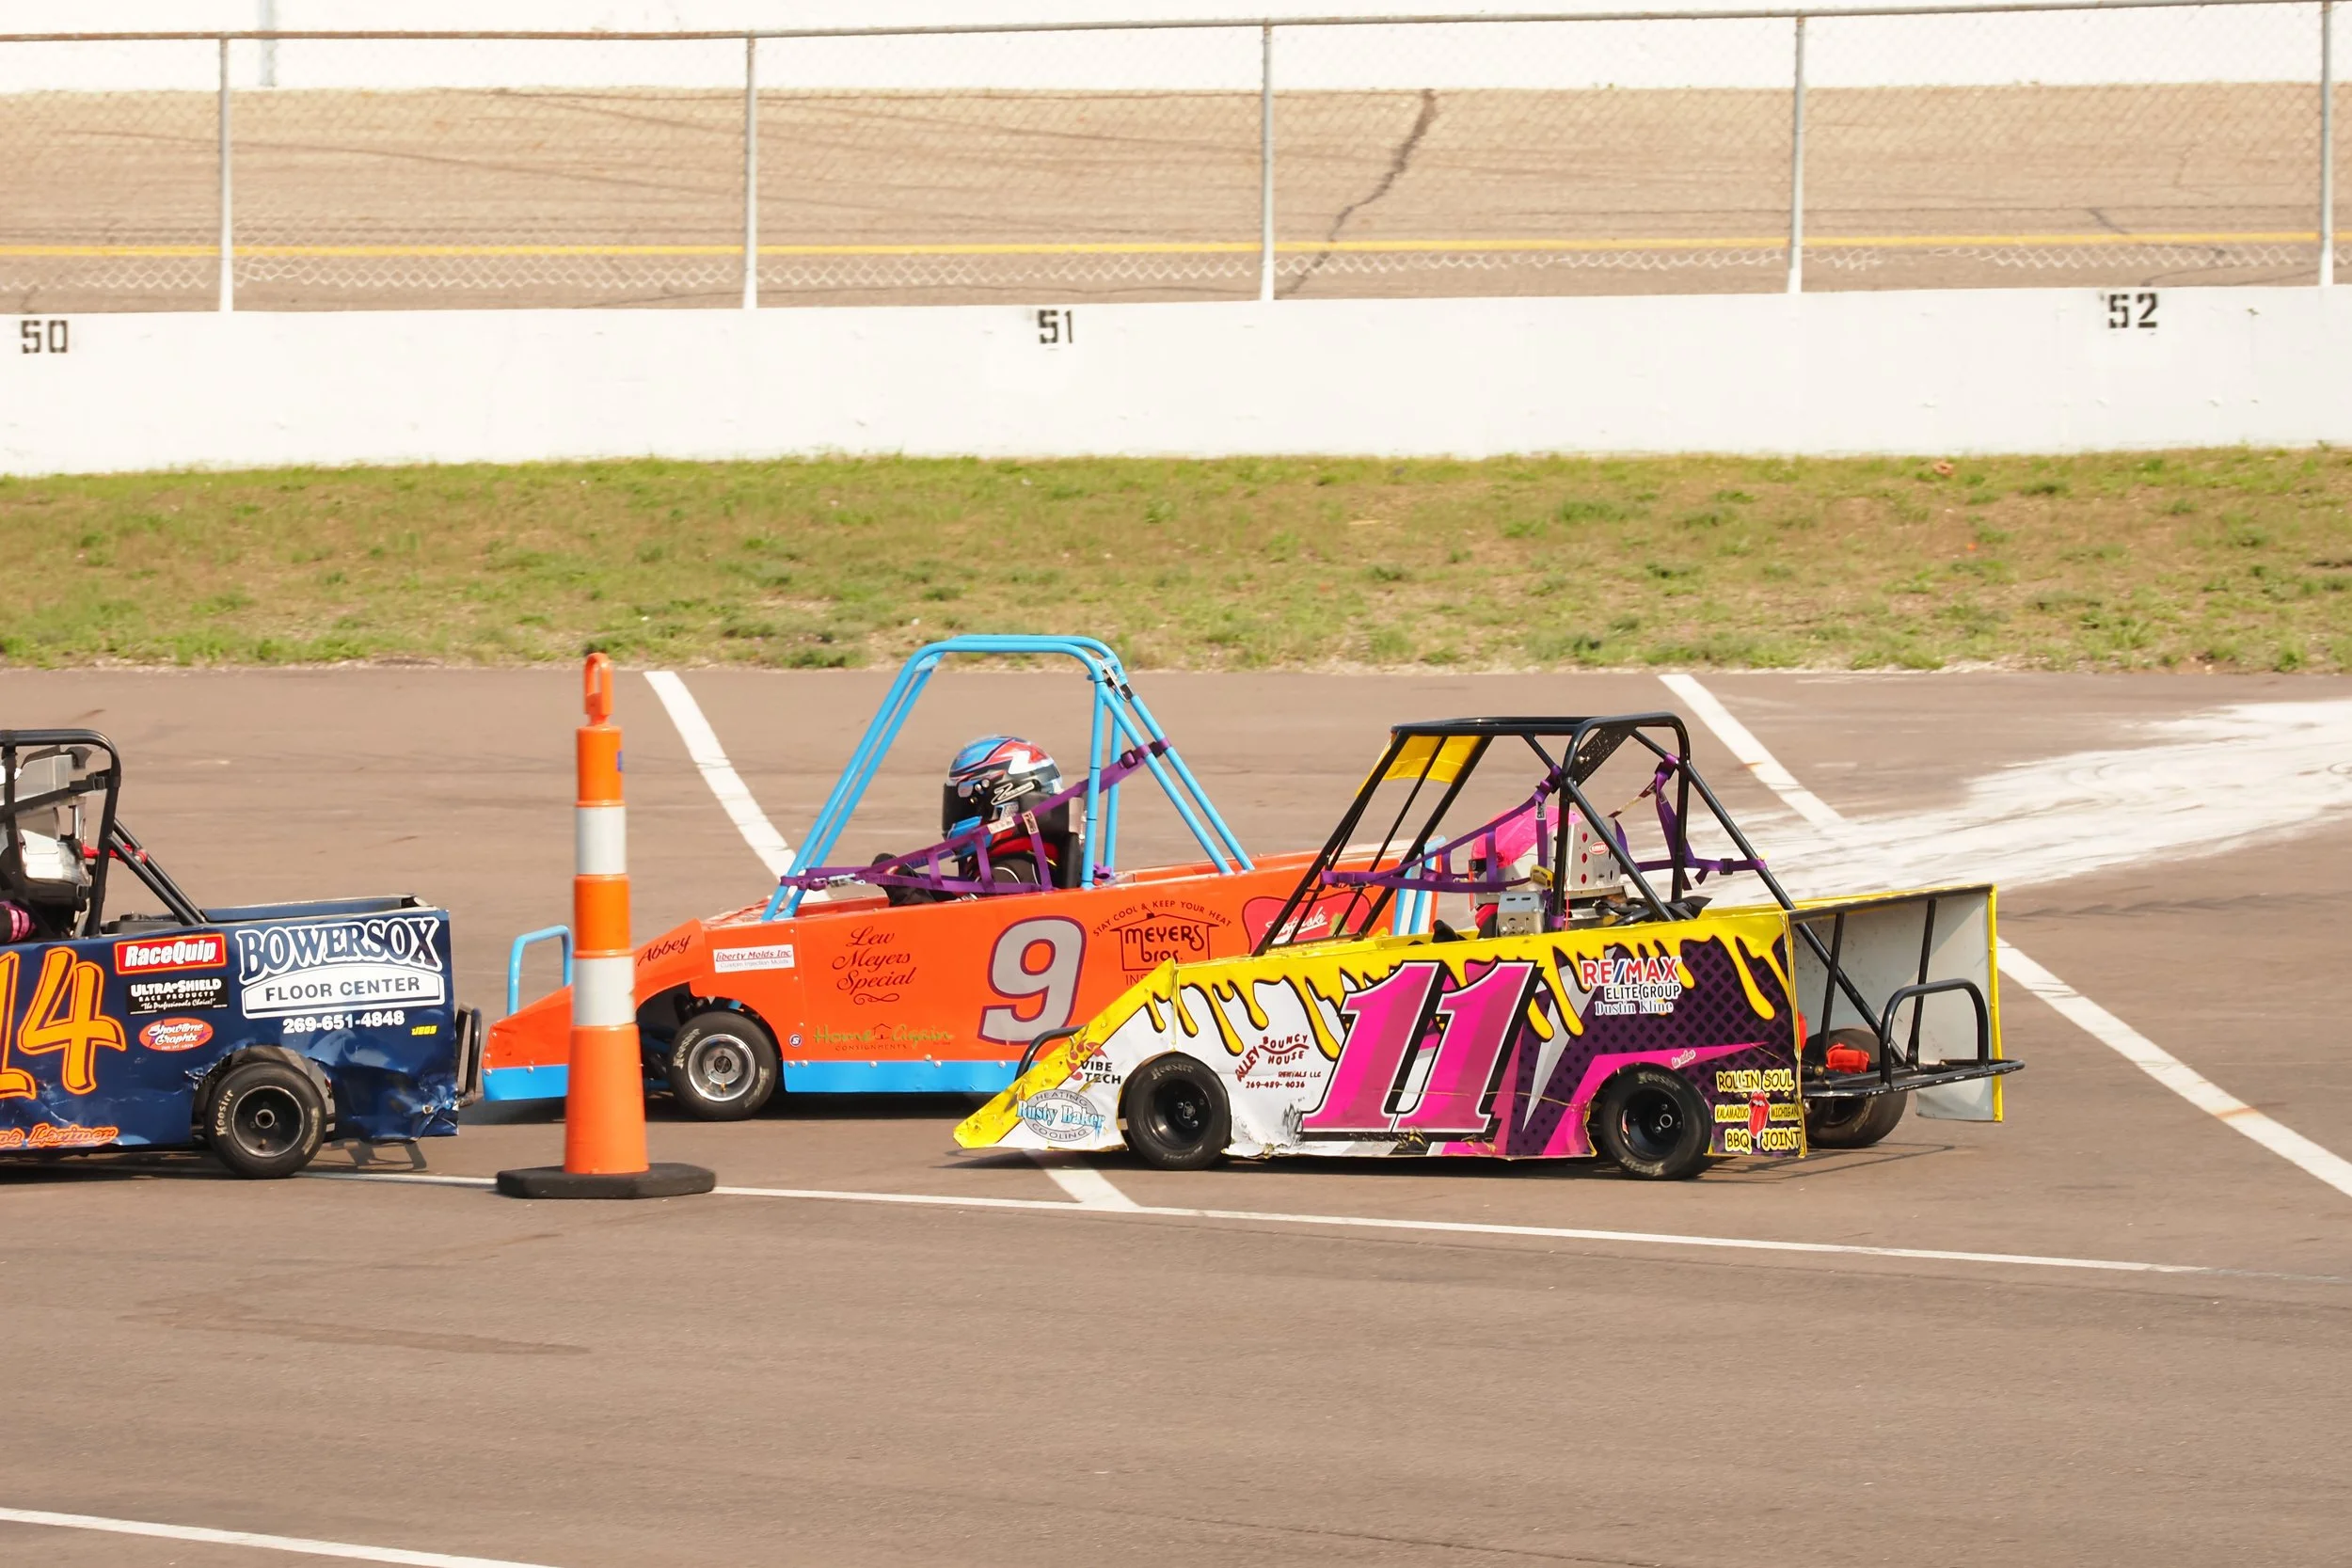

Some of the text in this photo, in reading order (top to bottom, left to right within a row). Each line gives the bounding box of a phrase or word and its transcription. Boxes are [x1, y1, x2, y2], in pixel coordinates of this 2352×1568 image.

[2109, 293, 2158, 329] 52
[21, 320, 68, 354] 50
[1038, 309, 1073, 344] 51
[1093, 919, 1112, 937] STAY
[1113, 906, 1137, 922] COOL
[1152, 900, 1176, 909] KEEP
[1181, 901, 1205, 913] YOUR
[1208, 911, 1232, 927] HEAT
[846, 926, 895, 947] Lew
[124, 940, 217, 968] RaceQuip
[236, 917, 442, 985] BOWERSOX
[638, 935, 691, 966] Abbey
[715, 951, 746, 962] Liberty
[747, 950, 774, 959] Molds
[832, 947, 911, 973] Meyers
[836, 966, 917, 995] Special
[977, 915, 1087, 1046] 9
[1581, 958, 1679, 985] RE/MAX
[138, 990, 215, 1003] RACE PRODUCTS
[265, 976, 421, 1002] FLOOR CENTER
[1605, 985, 1680, 1000] ELITE GROUP
[1595, 1000, 1675, 1015] Dustin Kline
[283, 1010, 405, 1035] 269-651-4848
[814, 1023, 955, 1048] Home Again
[834, 1043, 908, 1052] CONSIGNMENTS
[1263, 1033, 1308, 1049] BOUNCY
[1267, 1050, 1305, 1065] HOUSE
[1298, 960, 1543, 1139] 11
[1080, 1060, 1113, 1072] VIBE
[1234, 1046, 1260, 1082] ALLEY
[1085, 1072, 1121, 1085] TECH
[1763, 1070, 1794, 1089] SOUL
[1035, 1092, 1089, 1107] HEATING
[1771, 1105, 1799, 1119] MICHIGAN
[1016, 1099, 1106, 1129] Rusty Baker
[1031, 1123, 1089, 1140] COOLING
[1726, 1130, 1801, 1150] BBQ JOINT
